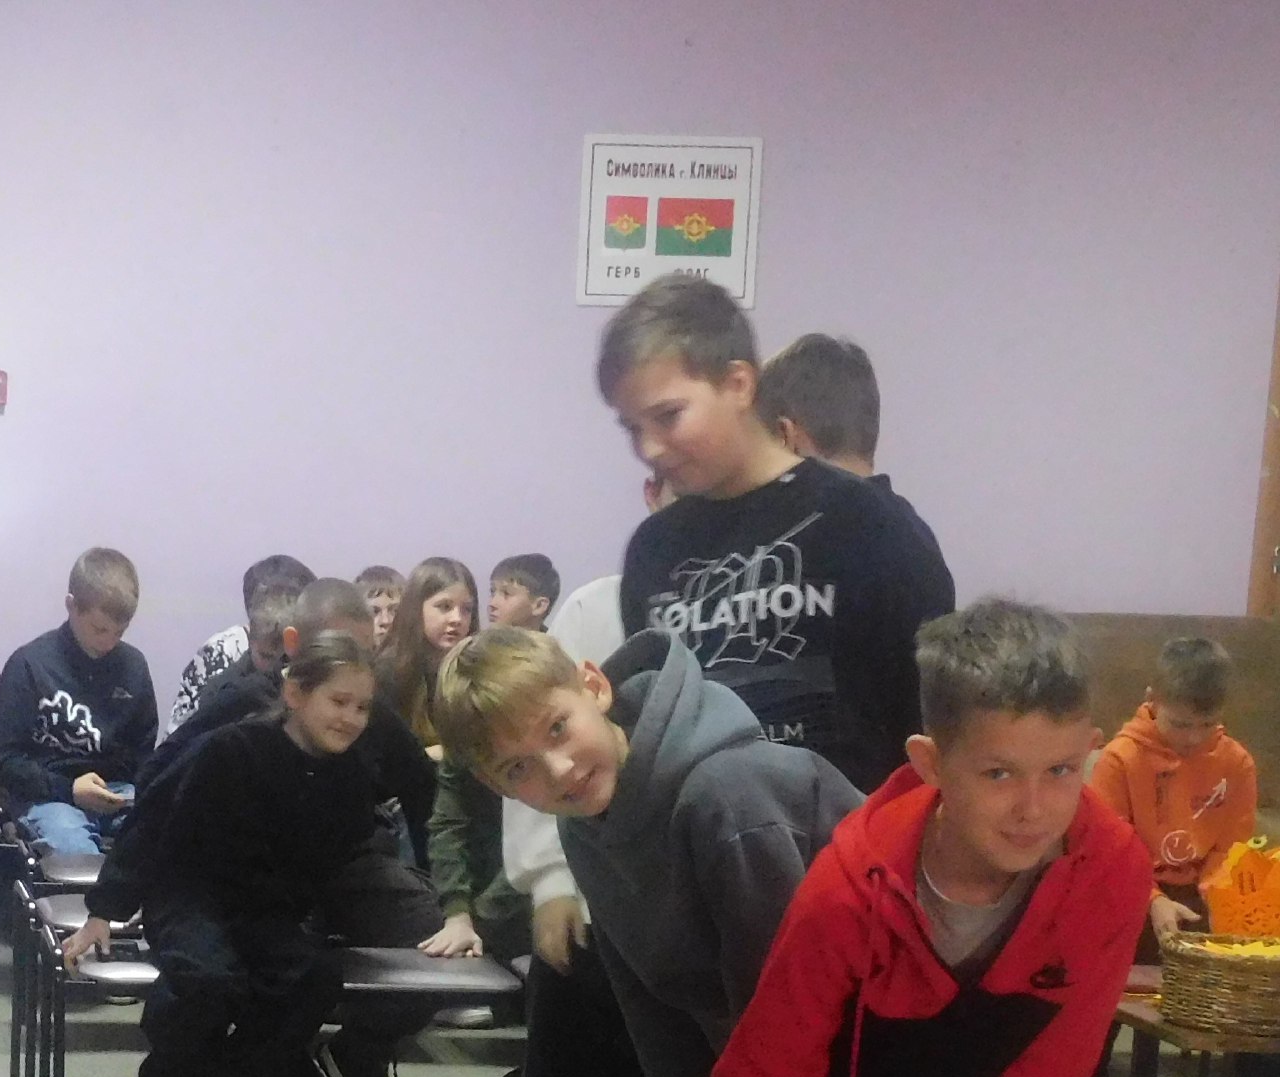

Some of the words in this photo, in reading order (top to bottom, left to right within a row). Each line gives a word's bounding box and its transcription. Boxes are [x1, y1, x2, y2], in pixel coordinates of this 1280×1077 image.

[606, 158, 675, 178] Символика
[690, 160, 737, 180] Клинцы
[606, 266, 641, 279] ГЕРБ
